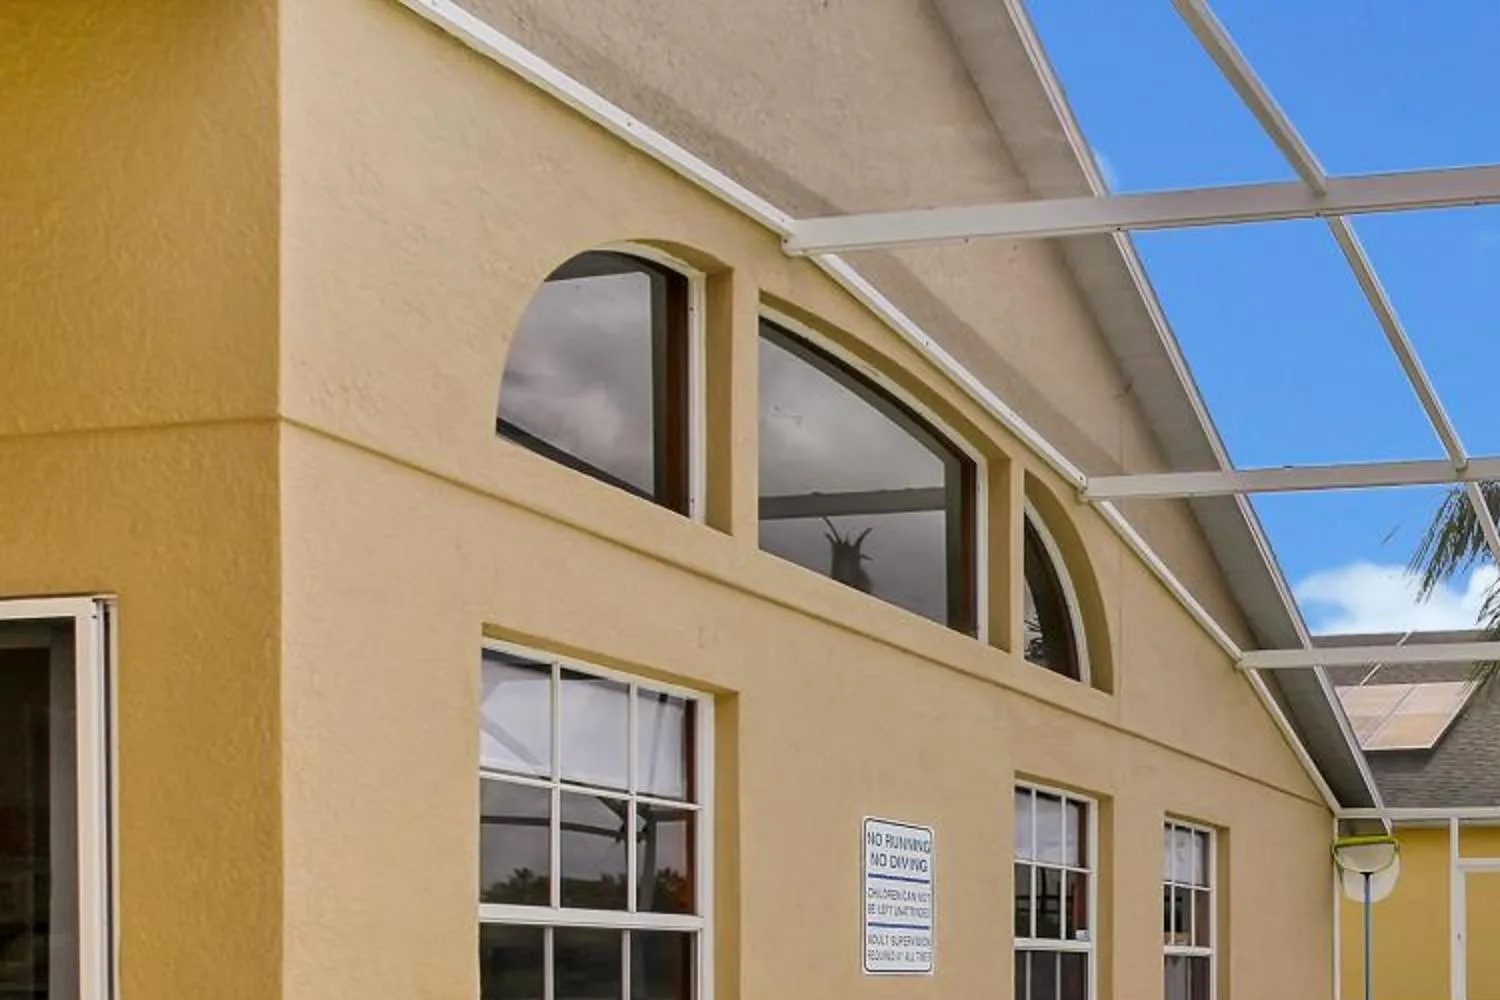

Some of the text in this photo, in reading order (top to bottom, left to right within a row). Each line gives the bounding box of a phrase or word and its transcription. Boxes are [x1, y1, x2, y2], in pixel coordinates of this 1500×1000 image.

[868, 832, 931, 854] NO RUNNING
[871, 852, 928, 872] NO DIVING
